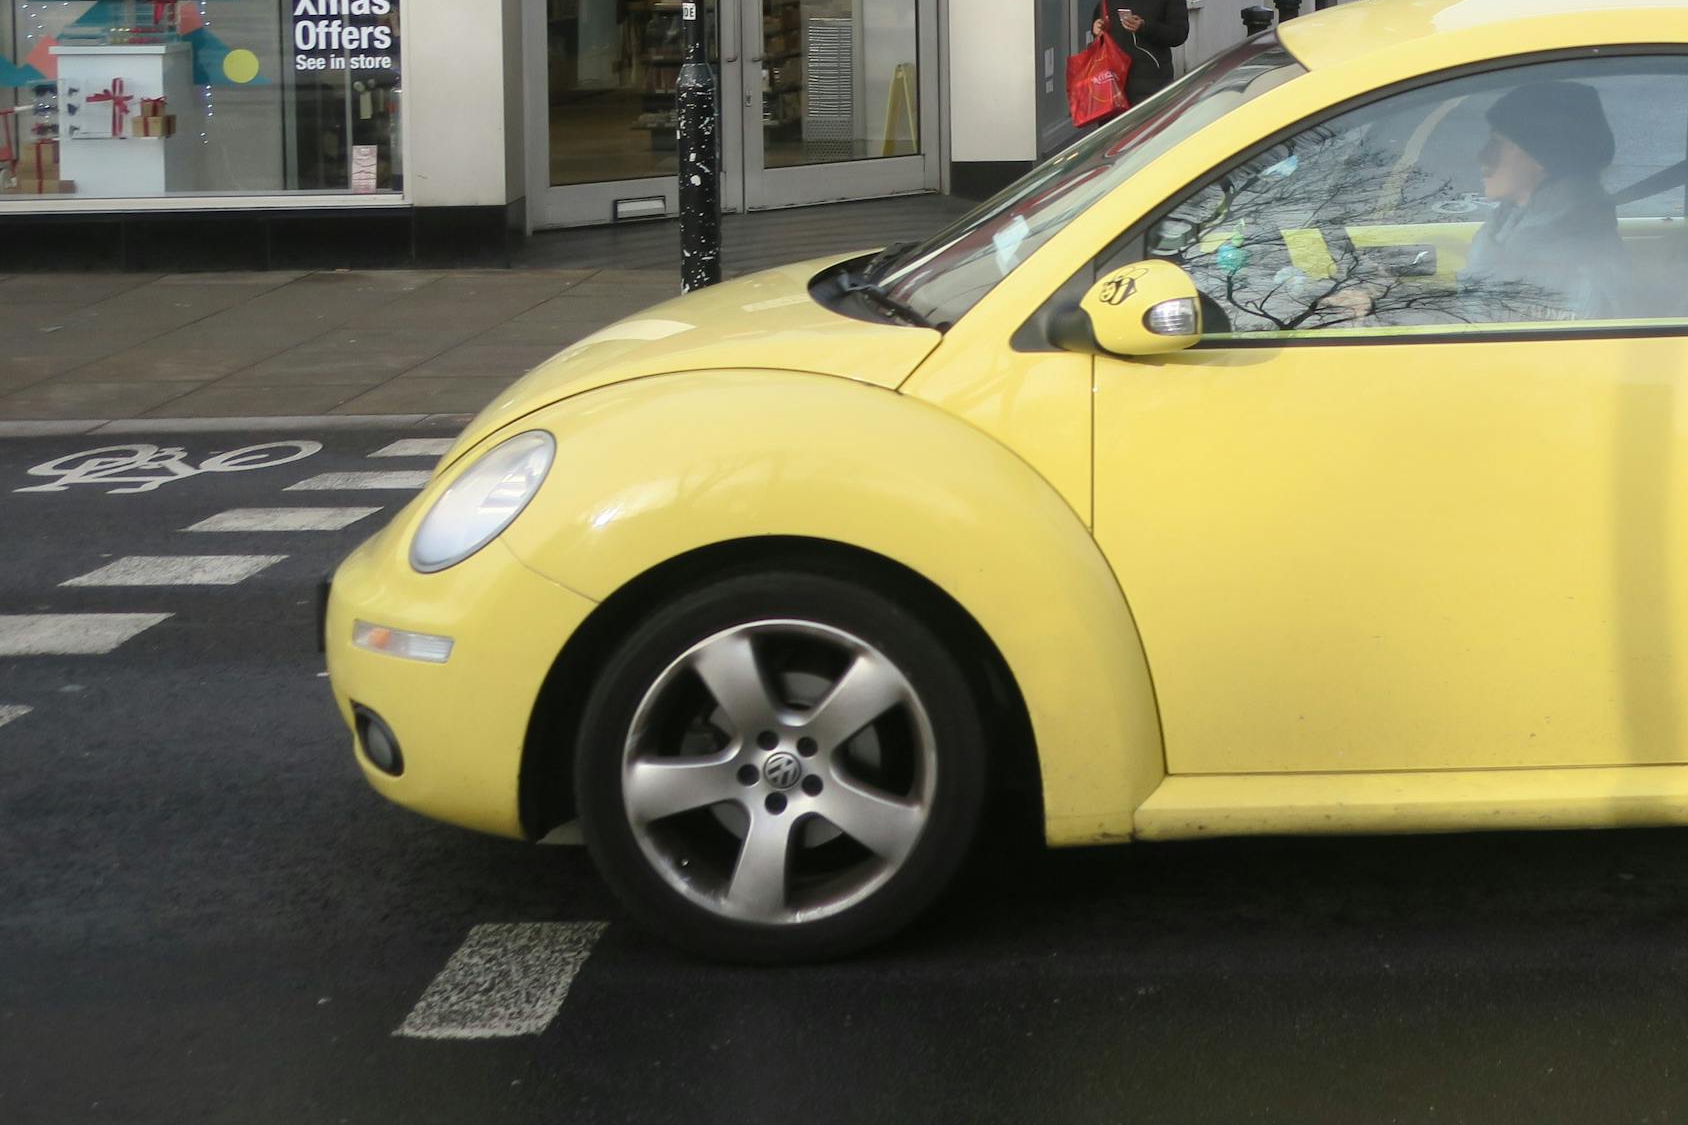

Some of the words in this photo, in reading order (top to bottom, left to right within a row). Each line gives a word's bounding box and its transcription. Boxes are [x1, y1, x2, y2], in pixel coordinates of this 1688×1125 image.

[295, 20, 392, 50] Offers
[295, 54, 327, 70] See
[330, 54, 345, 69] in
[350, 54, 392, 70] store
